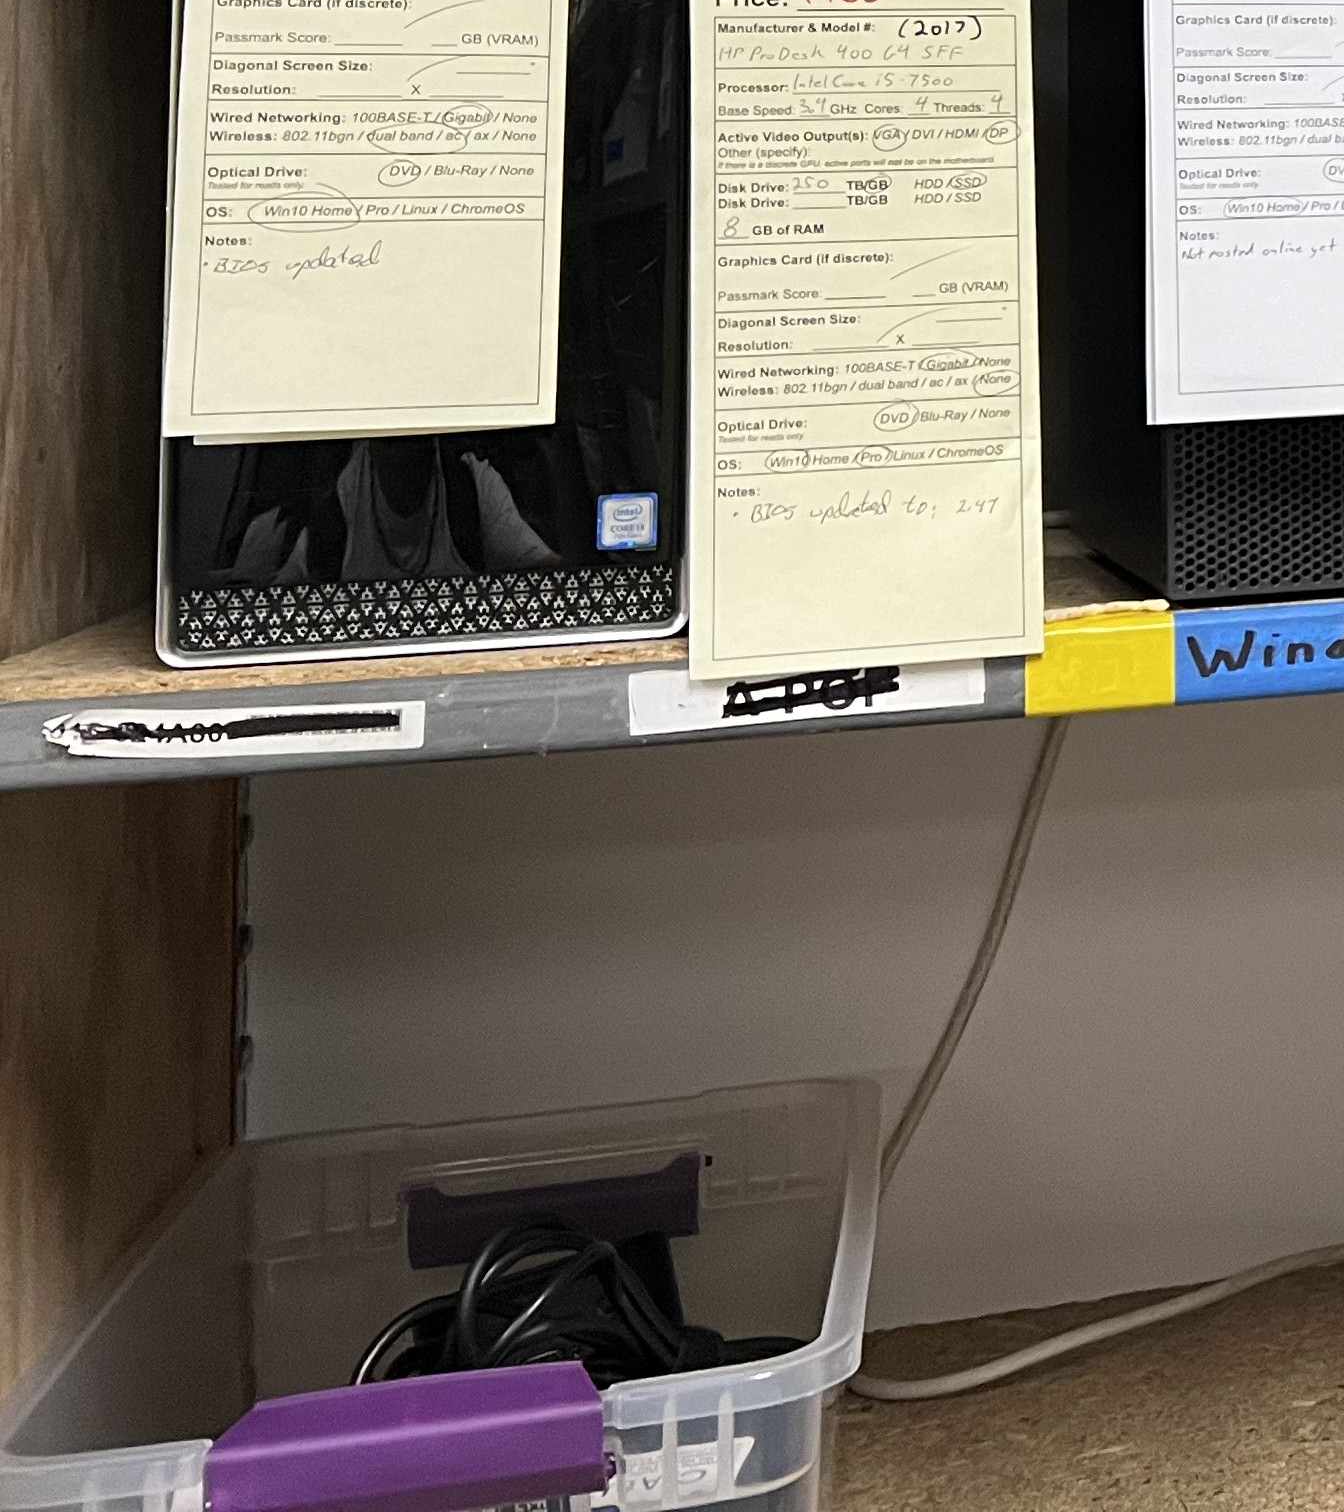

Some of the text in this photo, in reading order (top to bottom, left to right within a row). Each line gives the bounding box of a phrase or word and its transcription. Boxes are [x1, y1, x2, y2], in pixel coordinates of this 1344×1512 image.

[718, 16, 982, 40] Manufacturer Model (2017)
[719, 47, 744, 61] HP
[837, 47, 872, 60] 400
[921, 46, 963, 59] SFF
[719, 83, 789, 93] Processor:
[205, 236, 252, 247] Notes:
